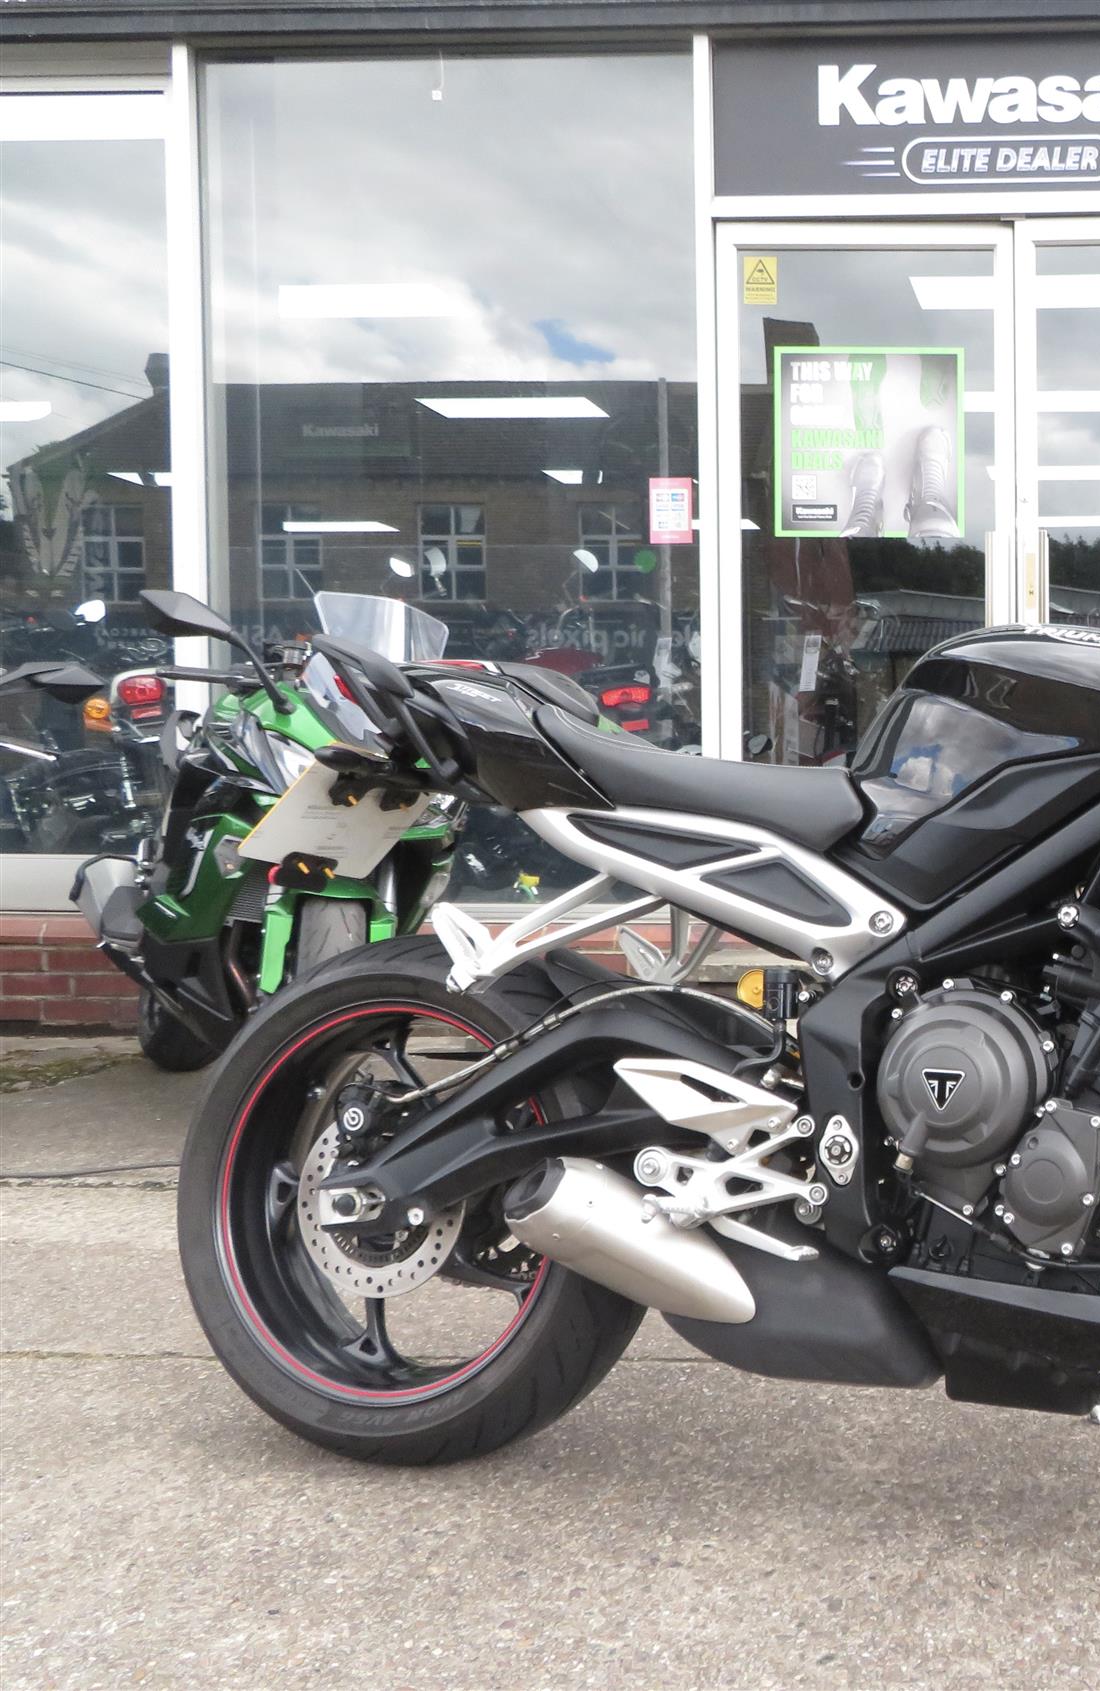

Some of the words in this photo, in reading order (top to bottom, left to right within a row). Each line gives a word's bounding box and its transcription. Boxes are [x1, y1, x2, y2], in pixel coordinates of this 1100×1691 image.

[921, 148, 992, 173] ELITE
[996, 145, 1100, 172] DEALER
[790, 361, 832, 382] THIS
[833, 361, 873, 382] WAY
[791, 428, 884, 450] KAWASAKI
[791, 451, 844, 471] DEALS
